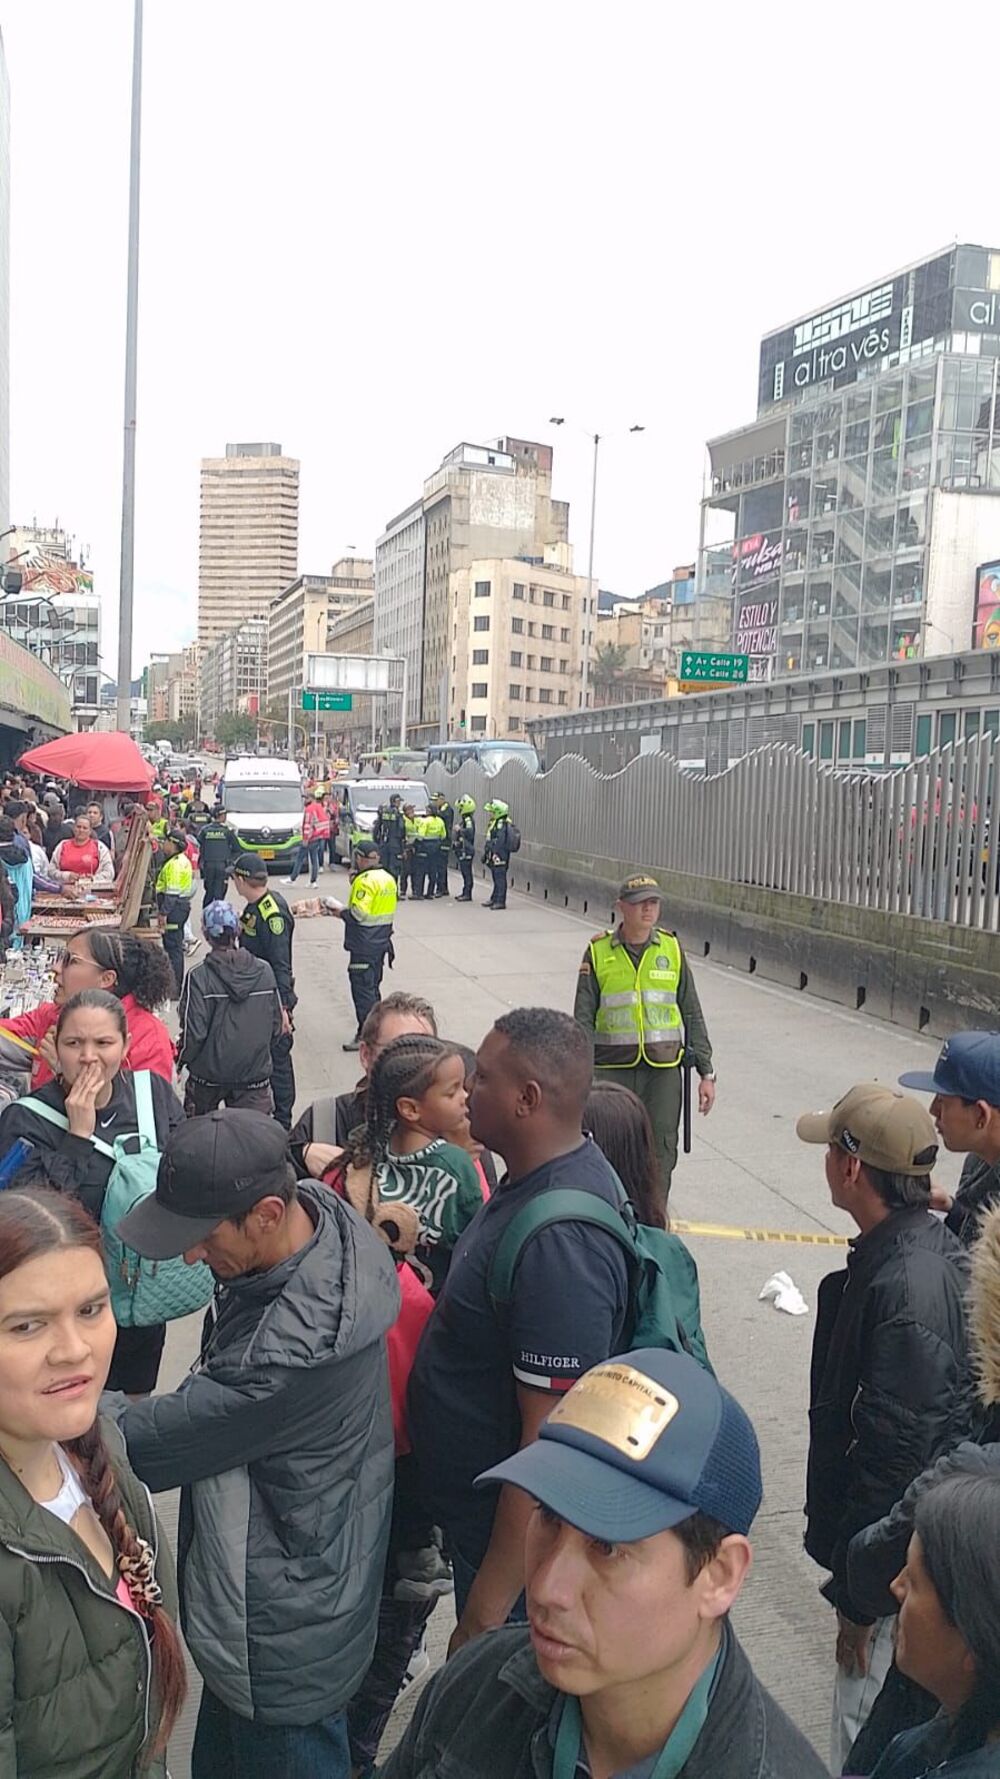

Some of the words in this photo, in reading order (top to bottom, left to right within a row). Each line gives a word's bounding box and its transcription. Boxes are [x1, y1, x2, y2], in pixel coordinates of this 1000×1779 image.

[739, 602, 769, 628] ESTILO
[769, 600, 777, 624] Y
[736, 627, 777, 654] POTENCIA
[695, 656, 707, 665] Av
[710, 657, 731, 667] Calle
[733, 658, 743, 668] 19
[694, 668, 706, 676] Av
[709, 669, 730, 678] Calle
[732, 669, 744, 679] 26
[520, 1351, 581, 1369] HILFIGER
[621, 1375, 653, 1397] CAPITAL
